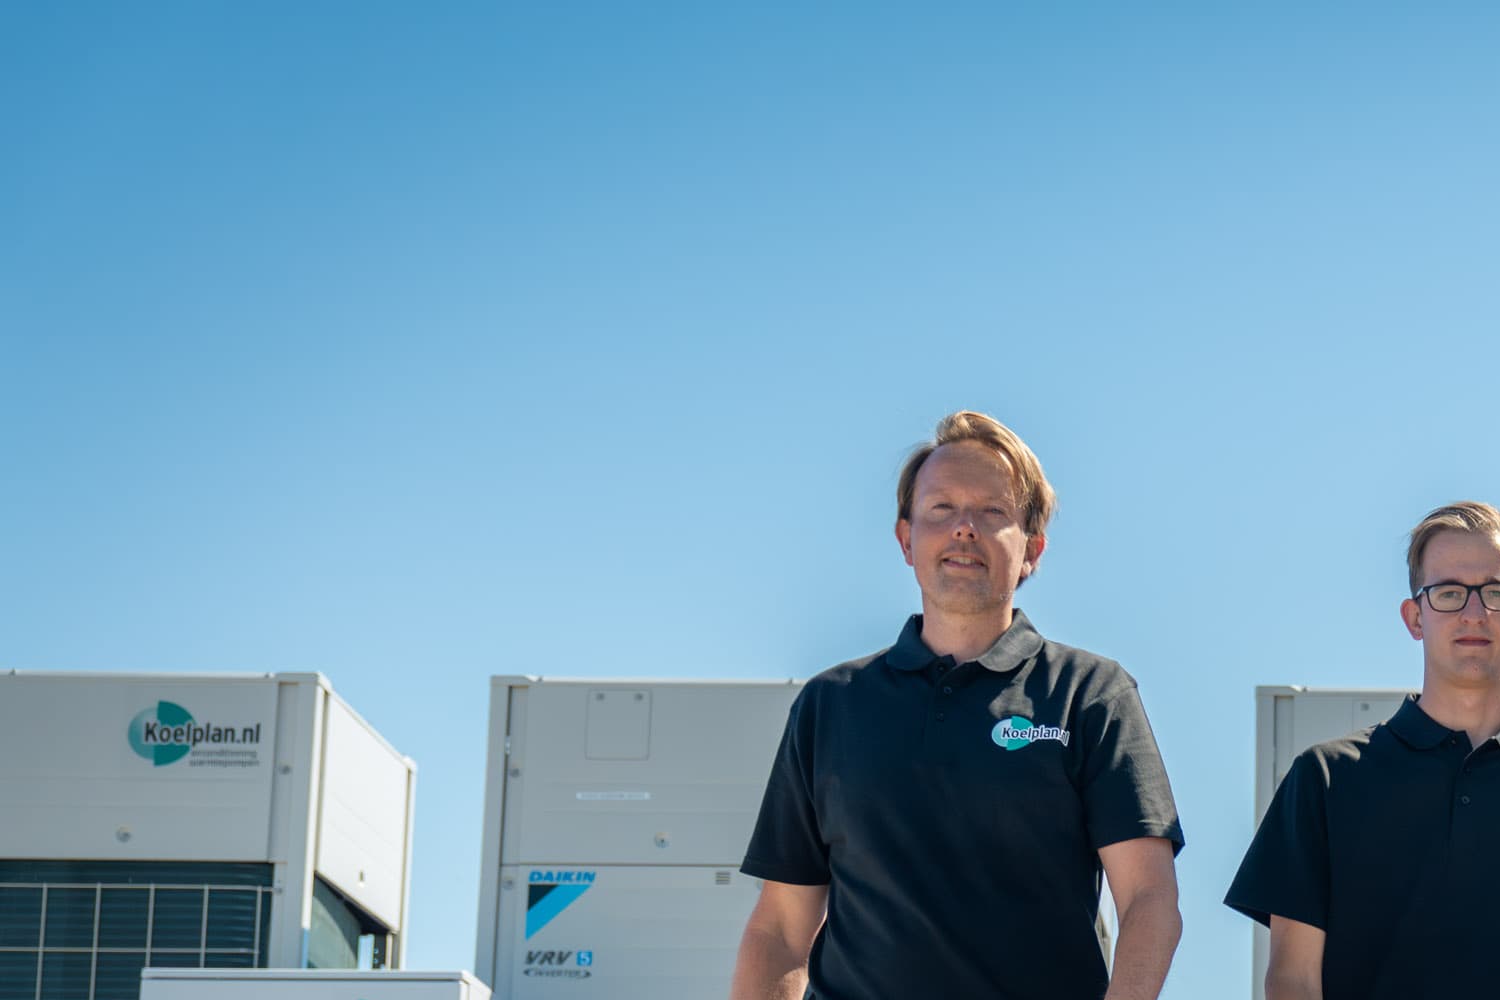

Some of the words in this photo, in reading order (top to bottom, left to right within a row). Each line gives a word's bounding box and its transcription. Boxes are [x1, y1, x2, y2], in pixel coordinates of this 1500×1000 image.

[144, 722, 260, 747] Koelplan.nl
[1002, 725, 1069, 746] Koelplannl
[528, 871, 596, 882] DAIKIN
[525, 951, 572, 965] VRV
